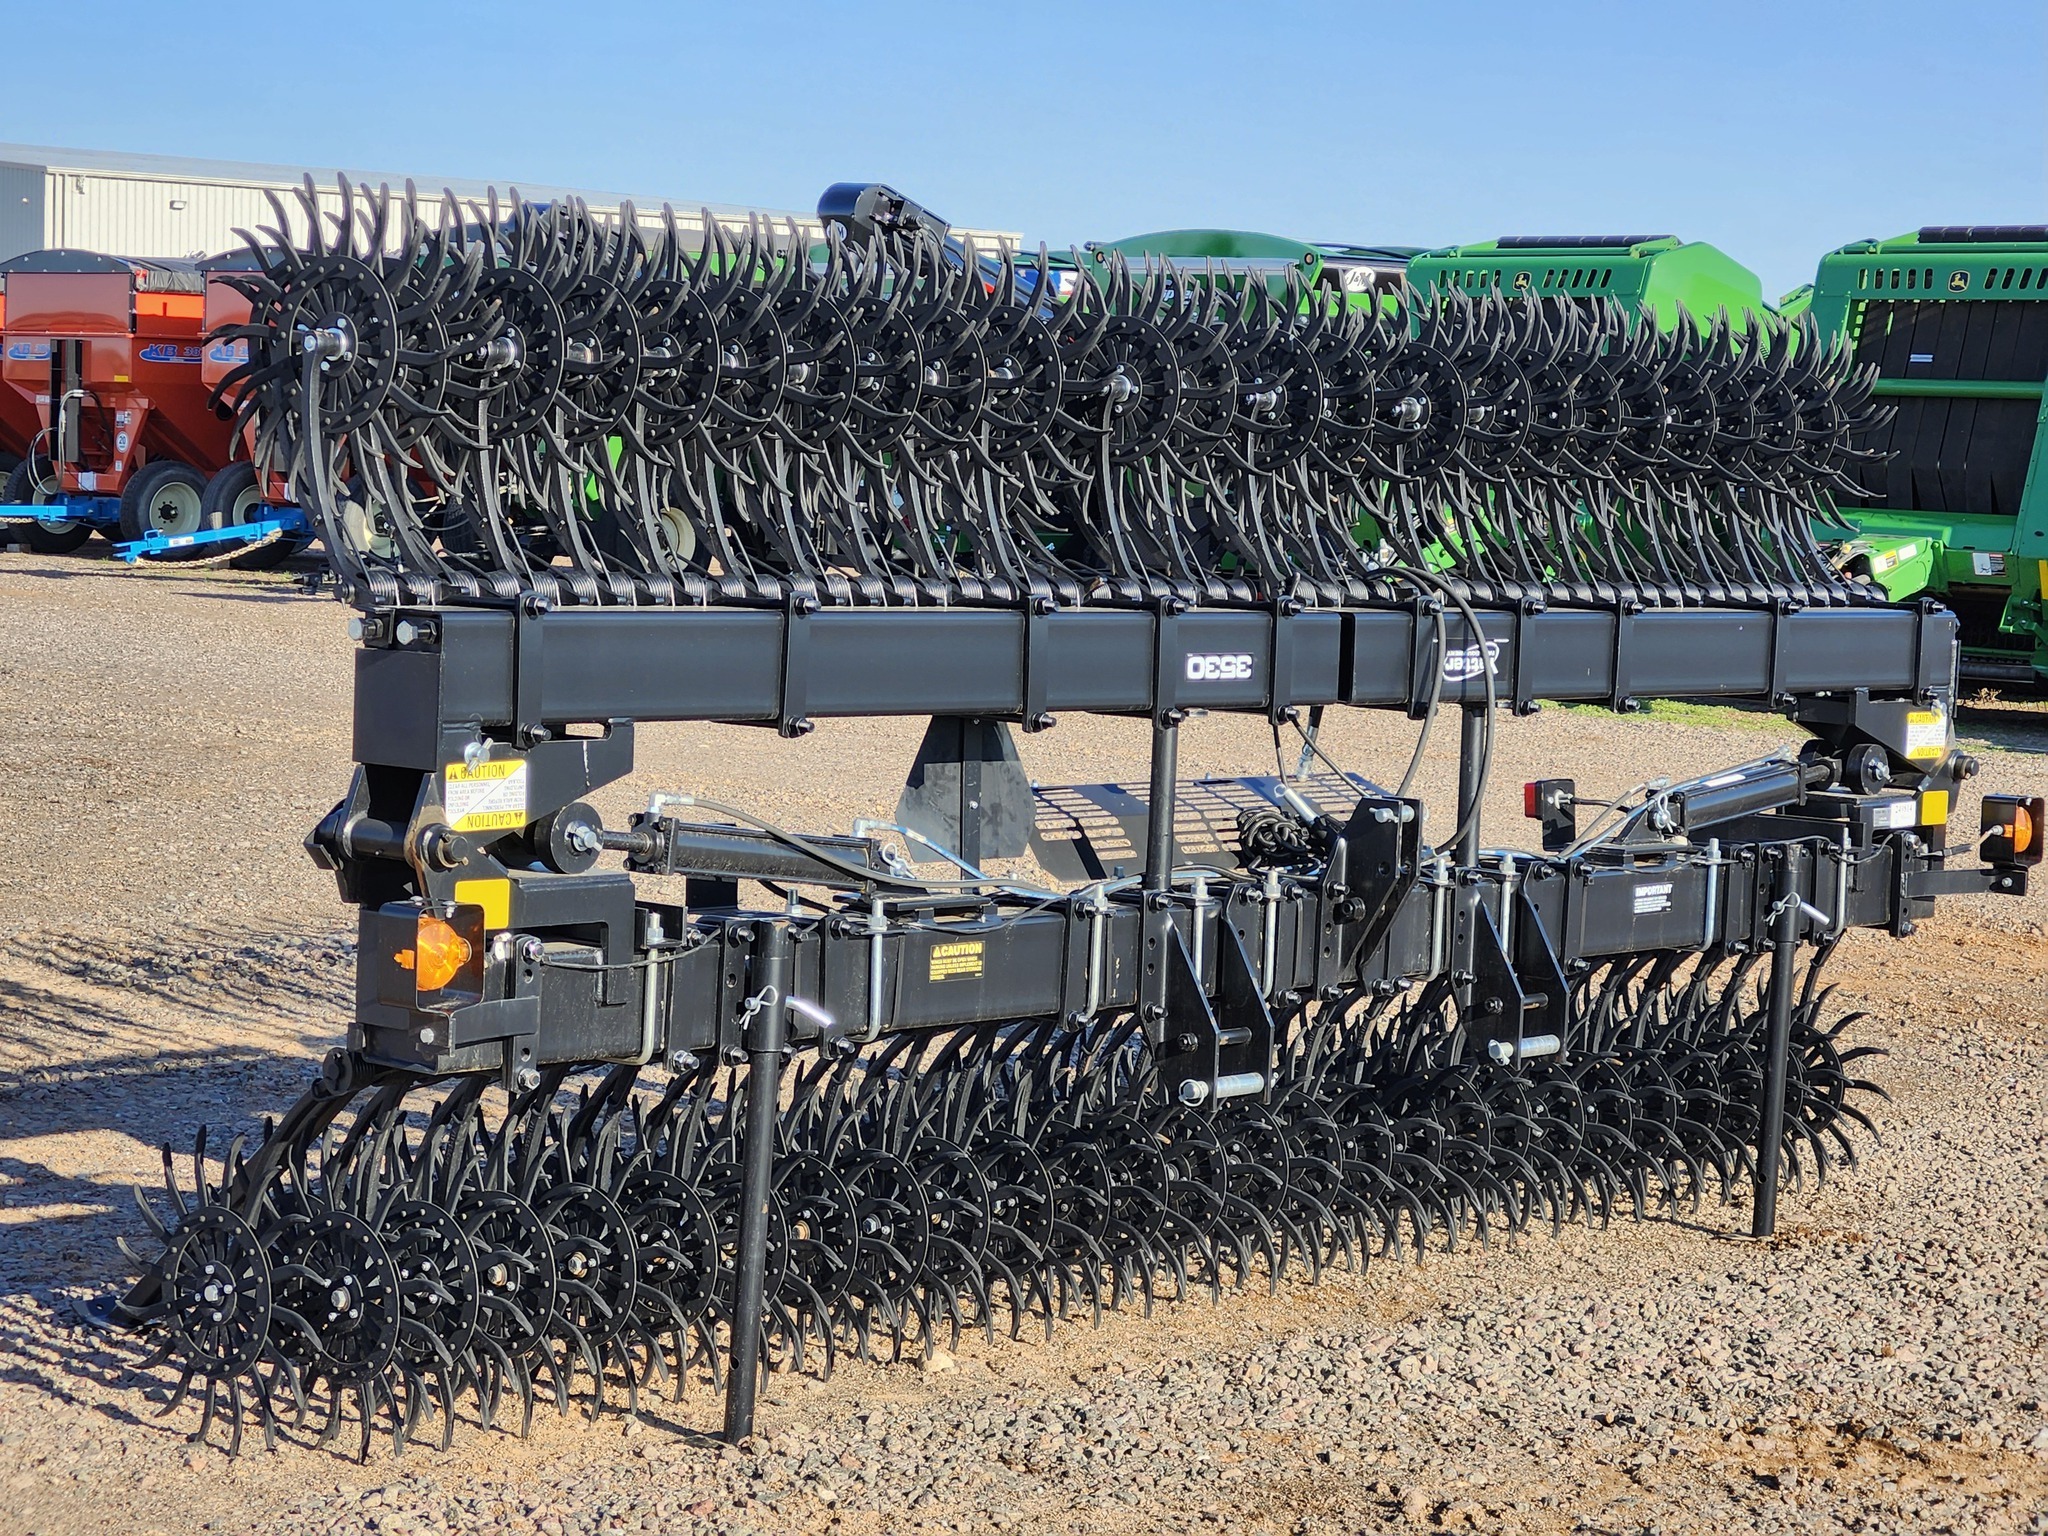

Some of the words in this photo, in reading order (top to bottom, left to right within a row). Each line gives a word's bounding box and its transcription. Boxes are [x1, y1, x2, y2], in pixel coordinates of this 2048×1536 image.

[148, 344, 178, 357] KB
[184, 346, 202, 356] 38
[1187, 655, 1252, 680] 3530
[467, 813, 512, 828] CAUTION
[1635, 883, 1673, 897] IMPORTANT
[941, 943, 983, 957] CAUTION
